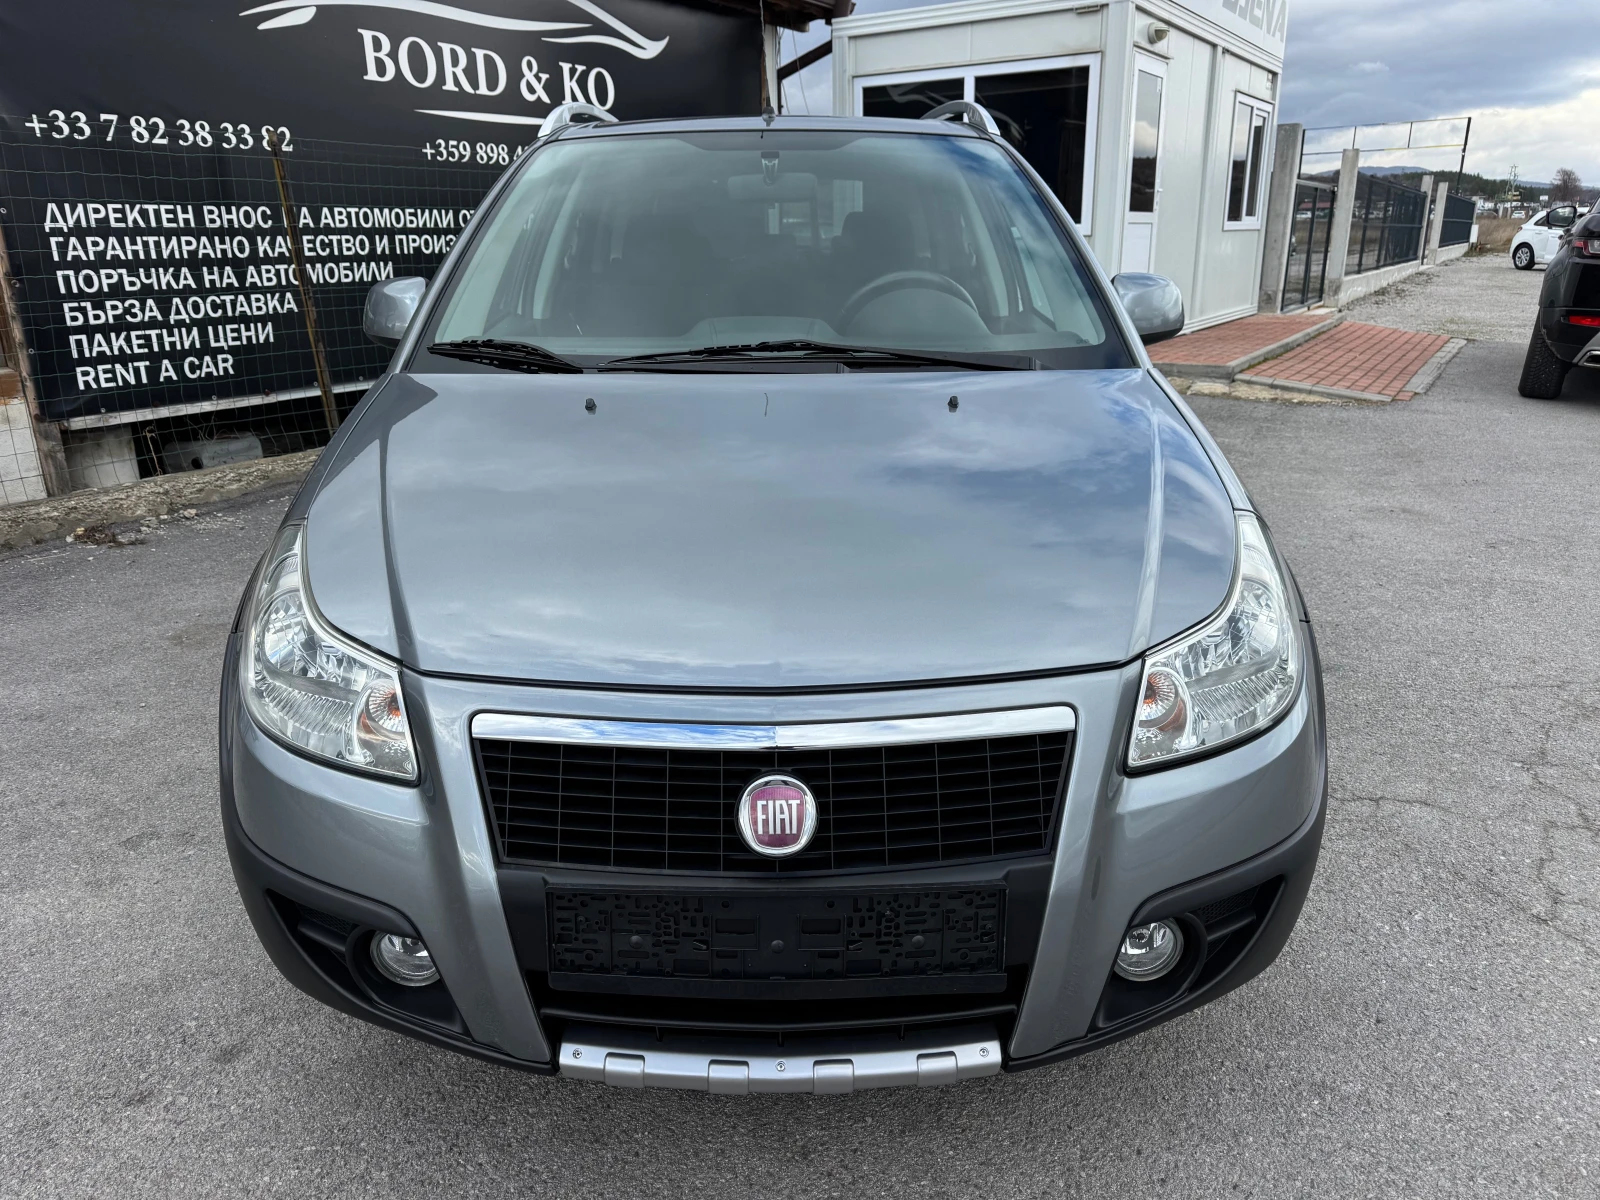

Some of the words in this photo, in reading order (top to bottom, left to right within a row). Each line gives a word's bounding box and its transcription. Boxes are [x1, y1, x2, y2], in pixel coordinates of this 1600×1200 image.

[357, 28, 507, 96] BORD
[519, 55, 551, 104] &
[558, 61, 615, 111] KO
[24, 109, 91, 140] +33
[99, 113, 118, 142] 7
[129, 115, 169, 145] 82
[176, 119, 213, 147] 38
[220, 122, 254, 150] 33
[261, 125, 293, 152] 82
[421, 138, 471, 162] +359
[475, 141, 510, 166] 898
[44, 202, 195, 232] ДИРЕКТЕН
[203, 205, 272, 229] ВНОС
[282, 206, 314, 228] А
[319, 207, 455, 229] АВТОМОБИЛИ
[50, 235, 250, 262] ГАРАНТИРАНО
[375, 234, 389, 255] И
[56, 265, 197, 295] ПОРЪЧКА
[203, 265, 239, 290] НА
[62, 298, 163, 328] БЪРЗА
[169, 291, 299, 322] ДОСТАВКА
[68, 327, 201, 360] ПАКЕТНИ
[207, 321, 275, 349] ЦЕНИ
[75, 361, 151, 391] RENT
[158, 359, 178, 381] A
[183, 353, 235, 380] CAR
[757, 800, 801, 835] FIAT
